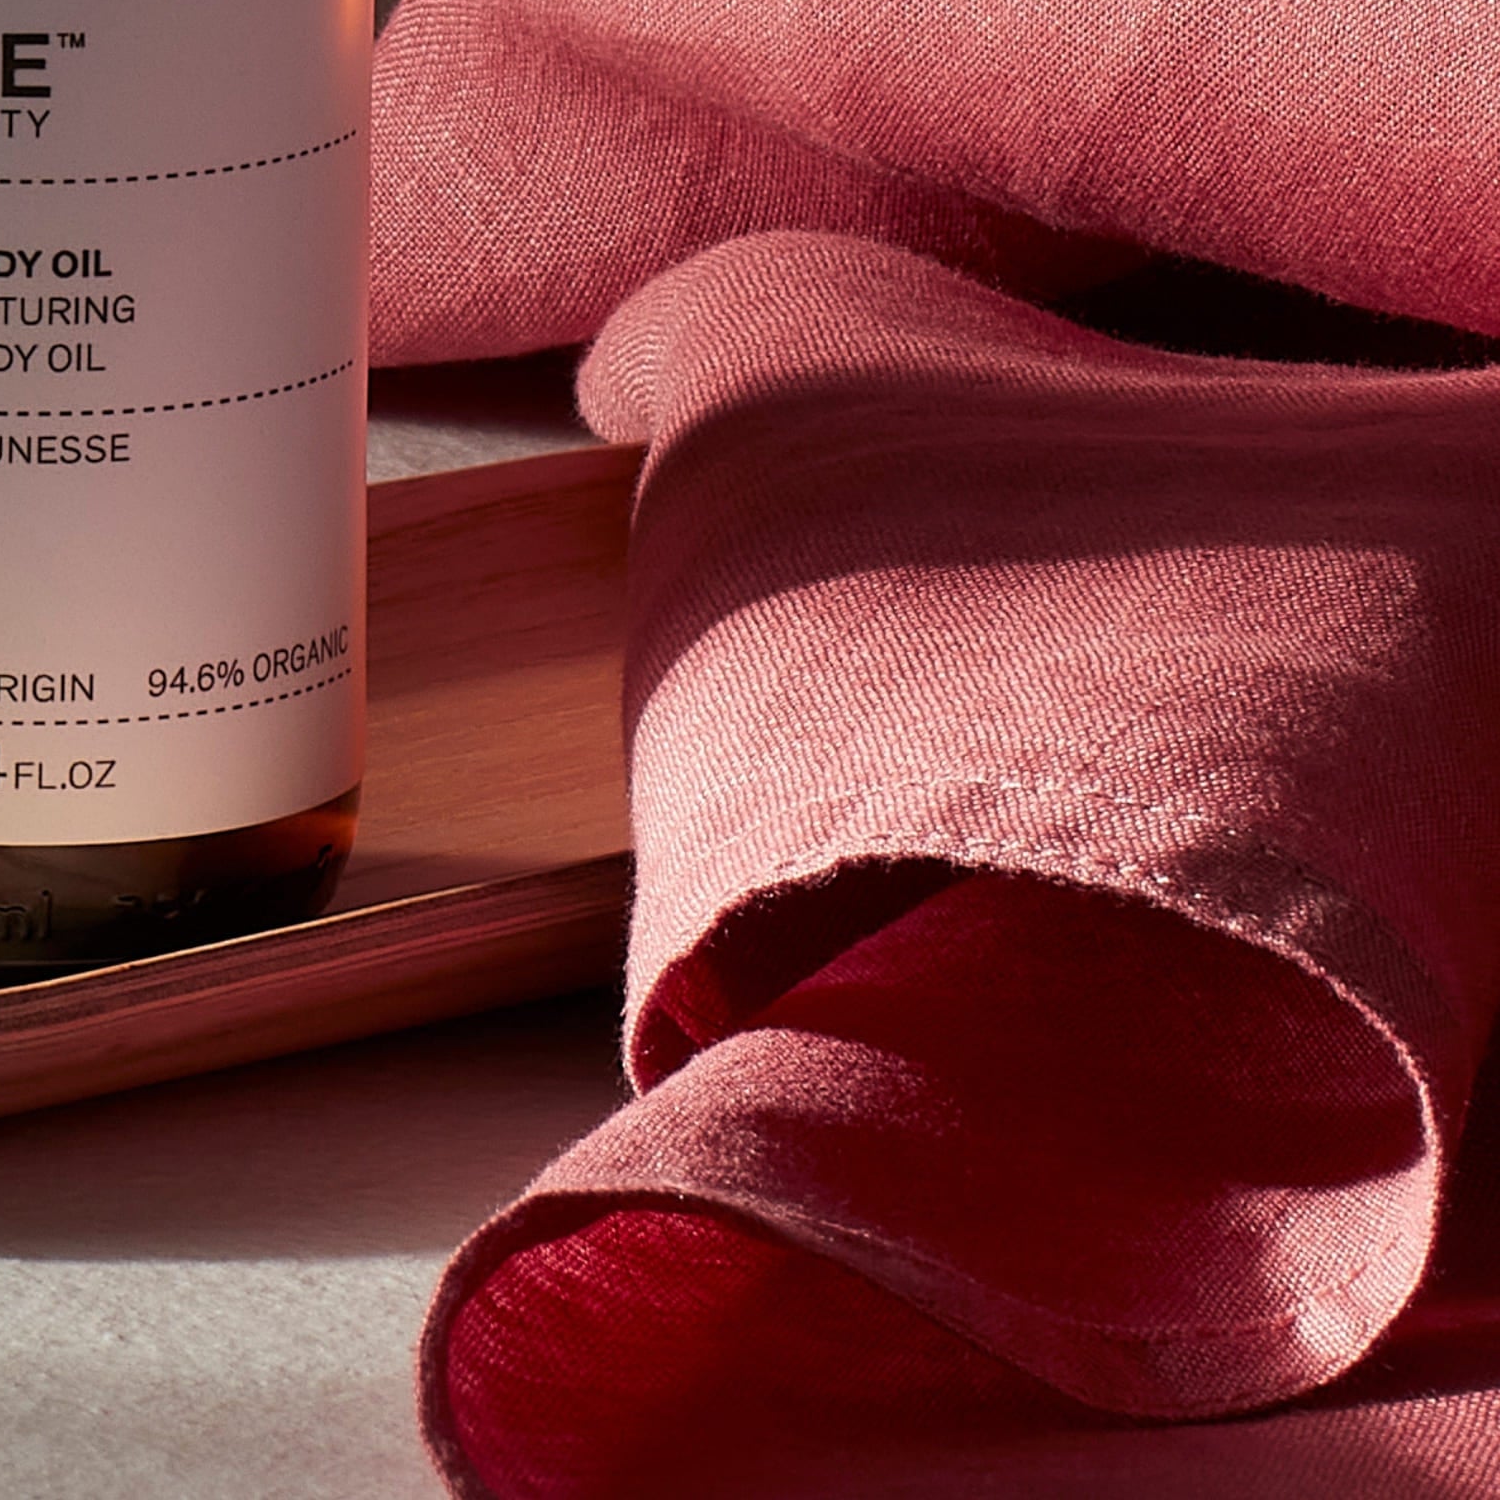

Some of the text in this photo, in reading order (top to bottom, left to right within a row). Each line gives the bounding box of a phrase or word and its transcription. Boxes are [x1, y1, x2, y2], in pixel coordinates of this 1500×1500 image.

[51, 249, 113, 279] OIL
[48, 342, 106, 373] OIL
[148, 624, 349, 698] 94.6% ORGANIC
